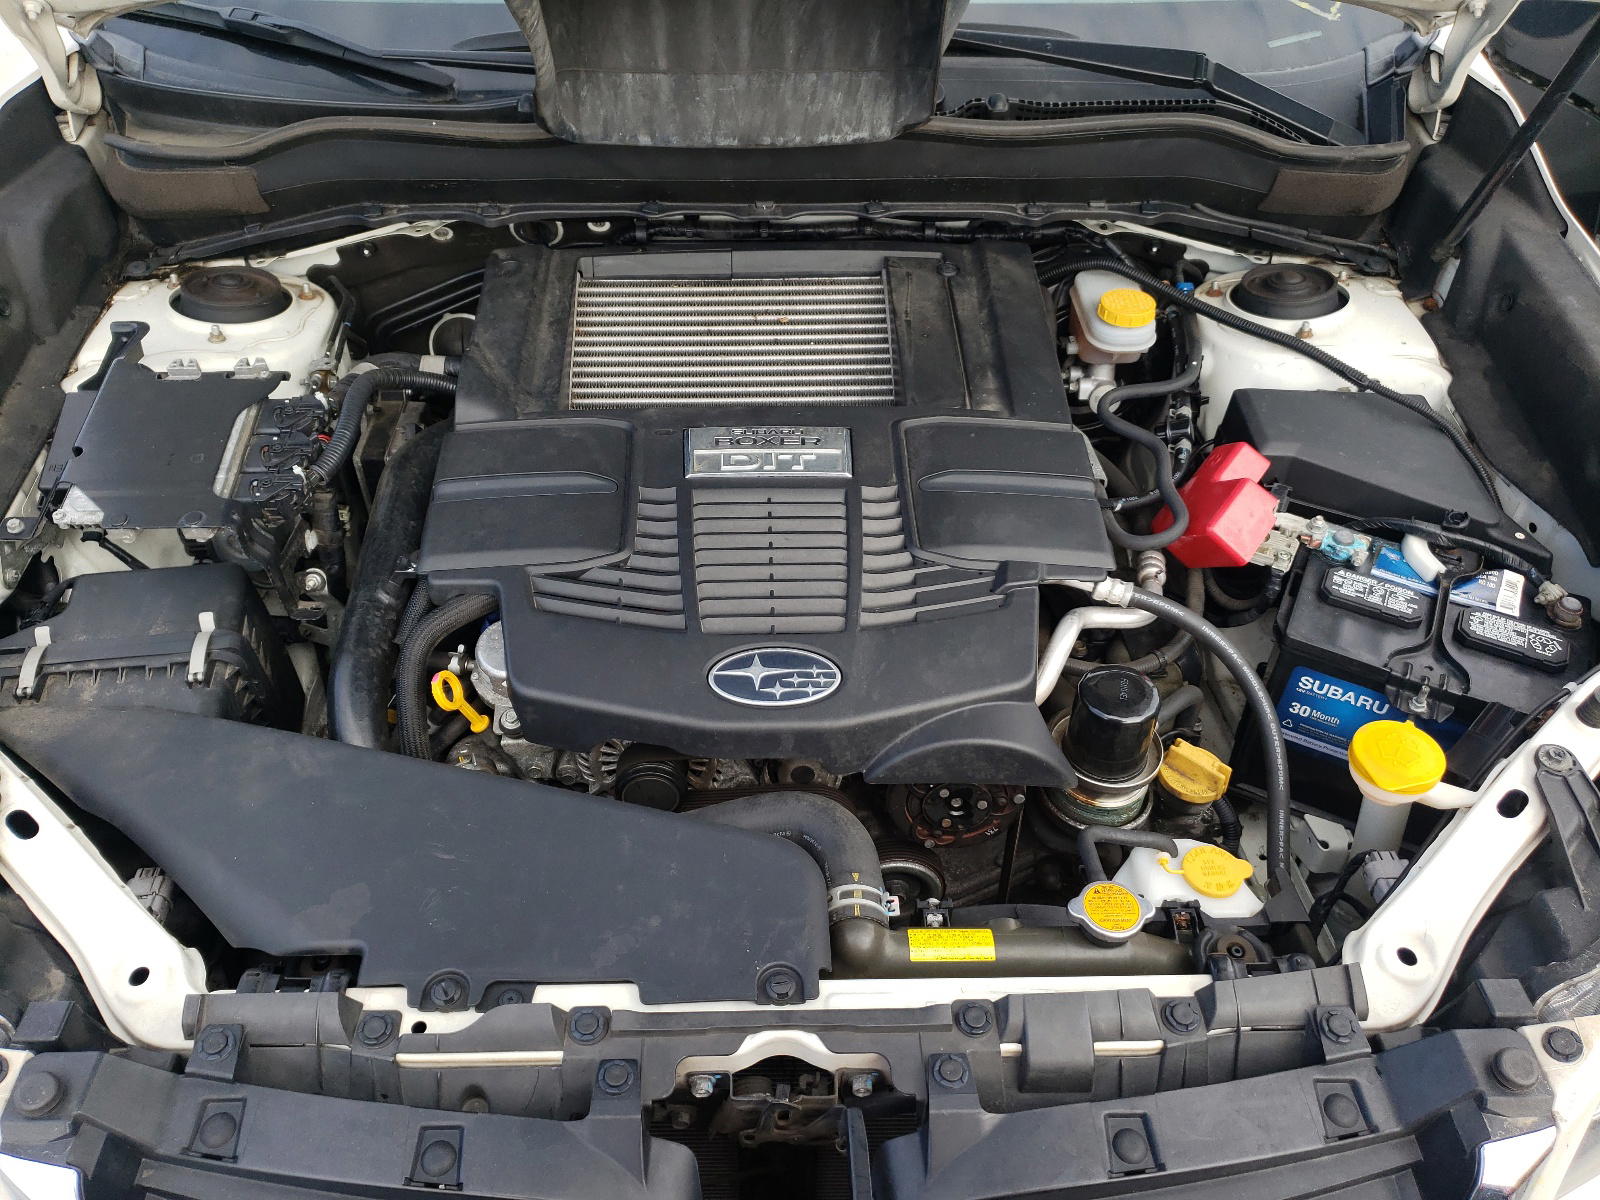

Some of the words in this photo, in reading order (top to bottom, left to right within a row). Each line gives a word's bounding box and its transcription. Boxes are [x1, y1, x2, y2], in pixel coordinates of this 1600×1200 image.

[714, 436, 822, 447] BOXER
[721, 453, 817, 471] DIT
[1298, 676, 1389, 715] SUBARU
[1289, 702, 1311, 717] 30
[1311, 709, 1340, 725] Month
